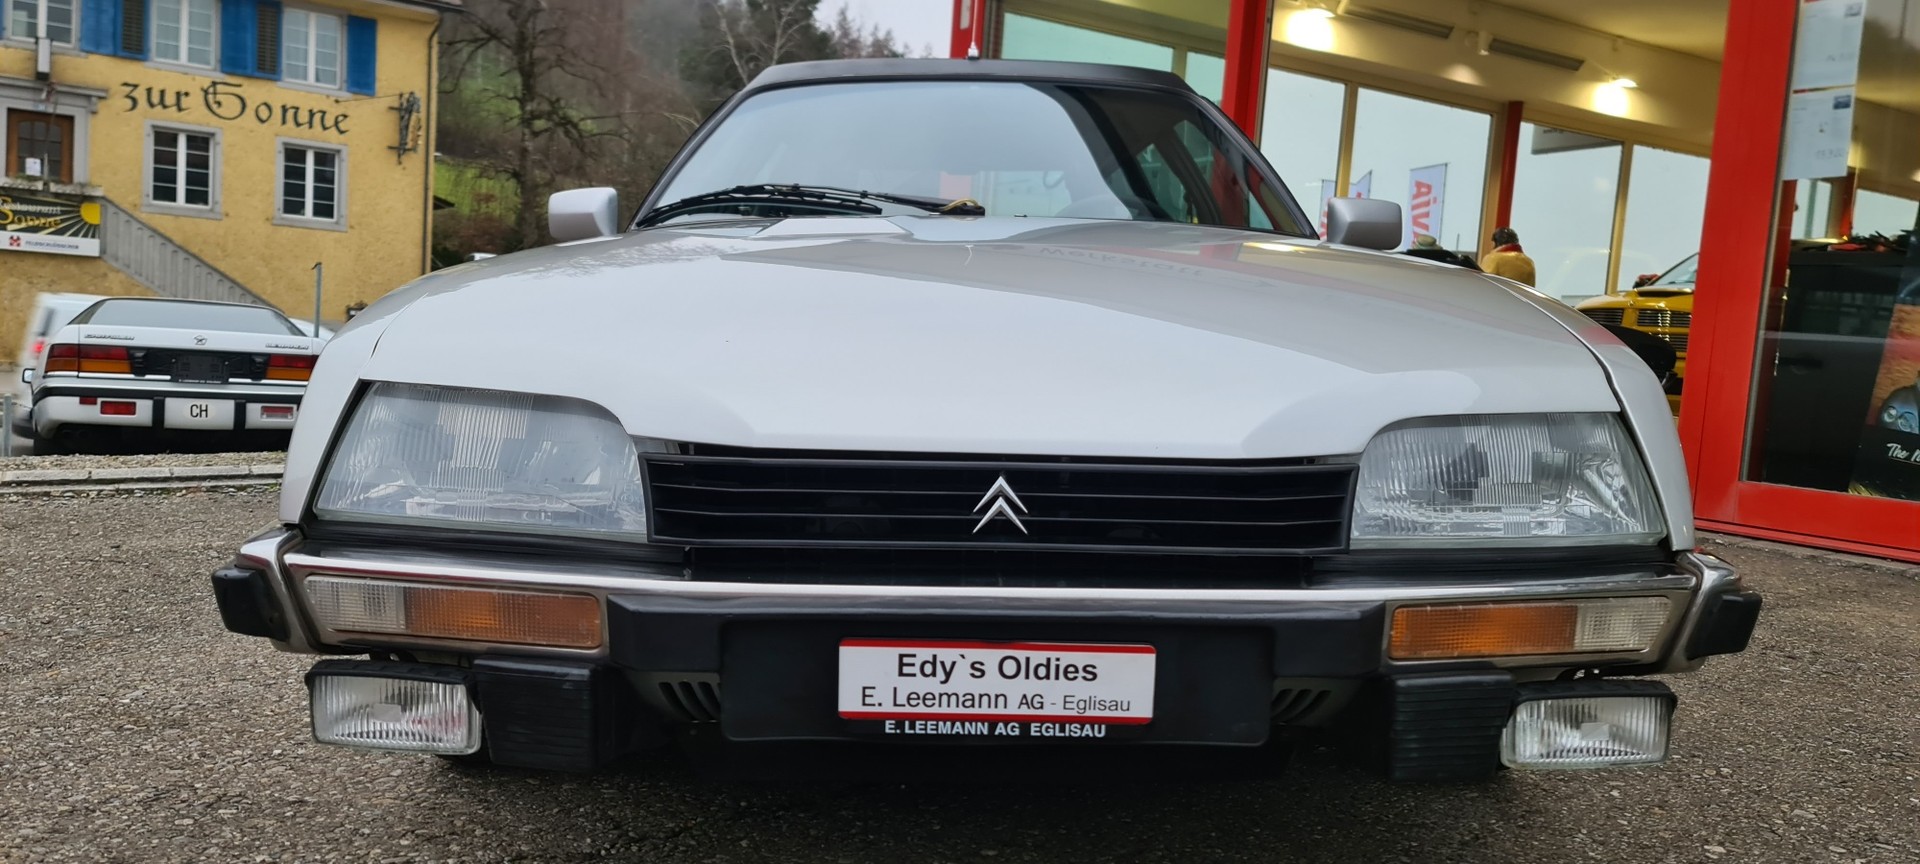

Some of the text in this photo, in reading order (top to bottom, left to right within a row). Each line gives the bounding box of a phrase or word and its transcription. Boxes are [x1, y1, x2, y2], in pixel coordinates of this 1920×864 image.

[120, 81, 350, 135] zur Sonne
[190, 403, 209, 419] CH
[1886, 443, 1910, 459] The
[998, 655, 1099, 682] Oldies
[861, 686, 882, 707] E.
[892, 686, 1008, 710] Leemann
[1018, 694, 1044, 711] AG
[1063, 695, 1131, 714] Eglisau
[885, 721, 1106, 738] E. LEEMANN AG EGLISAU
